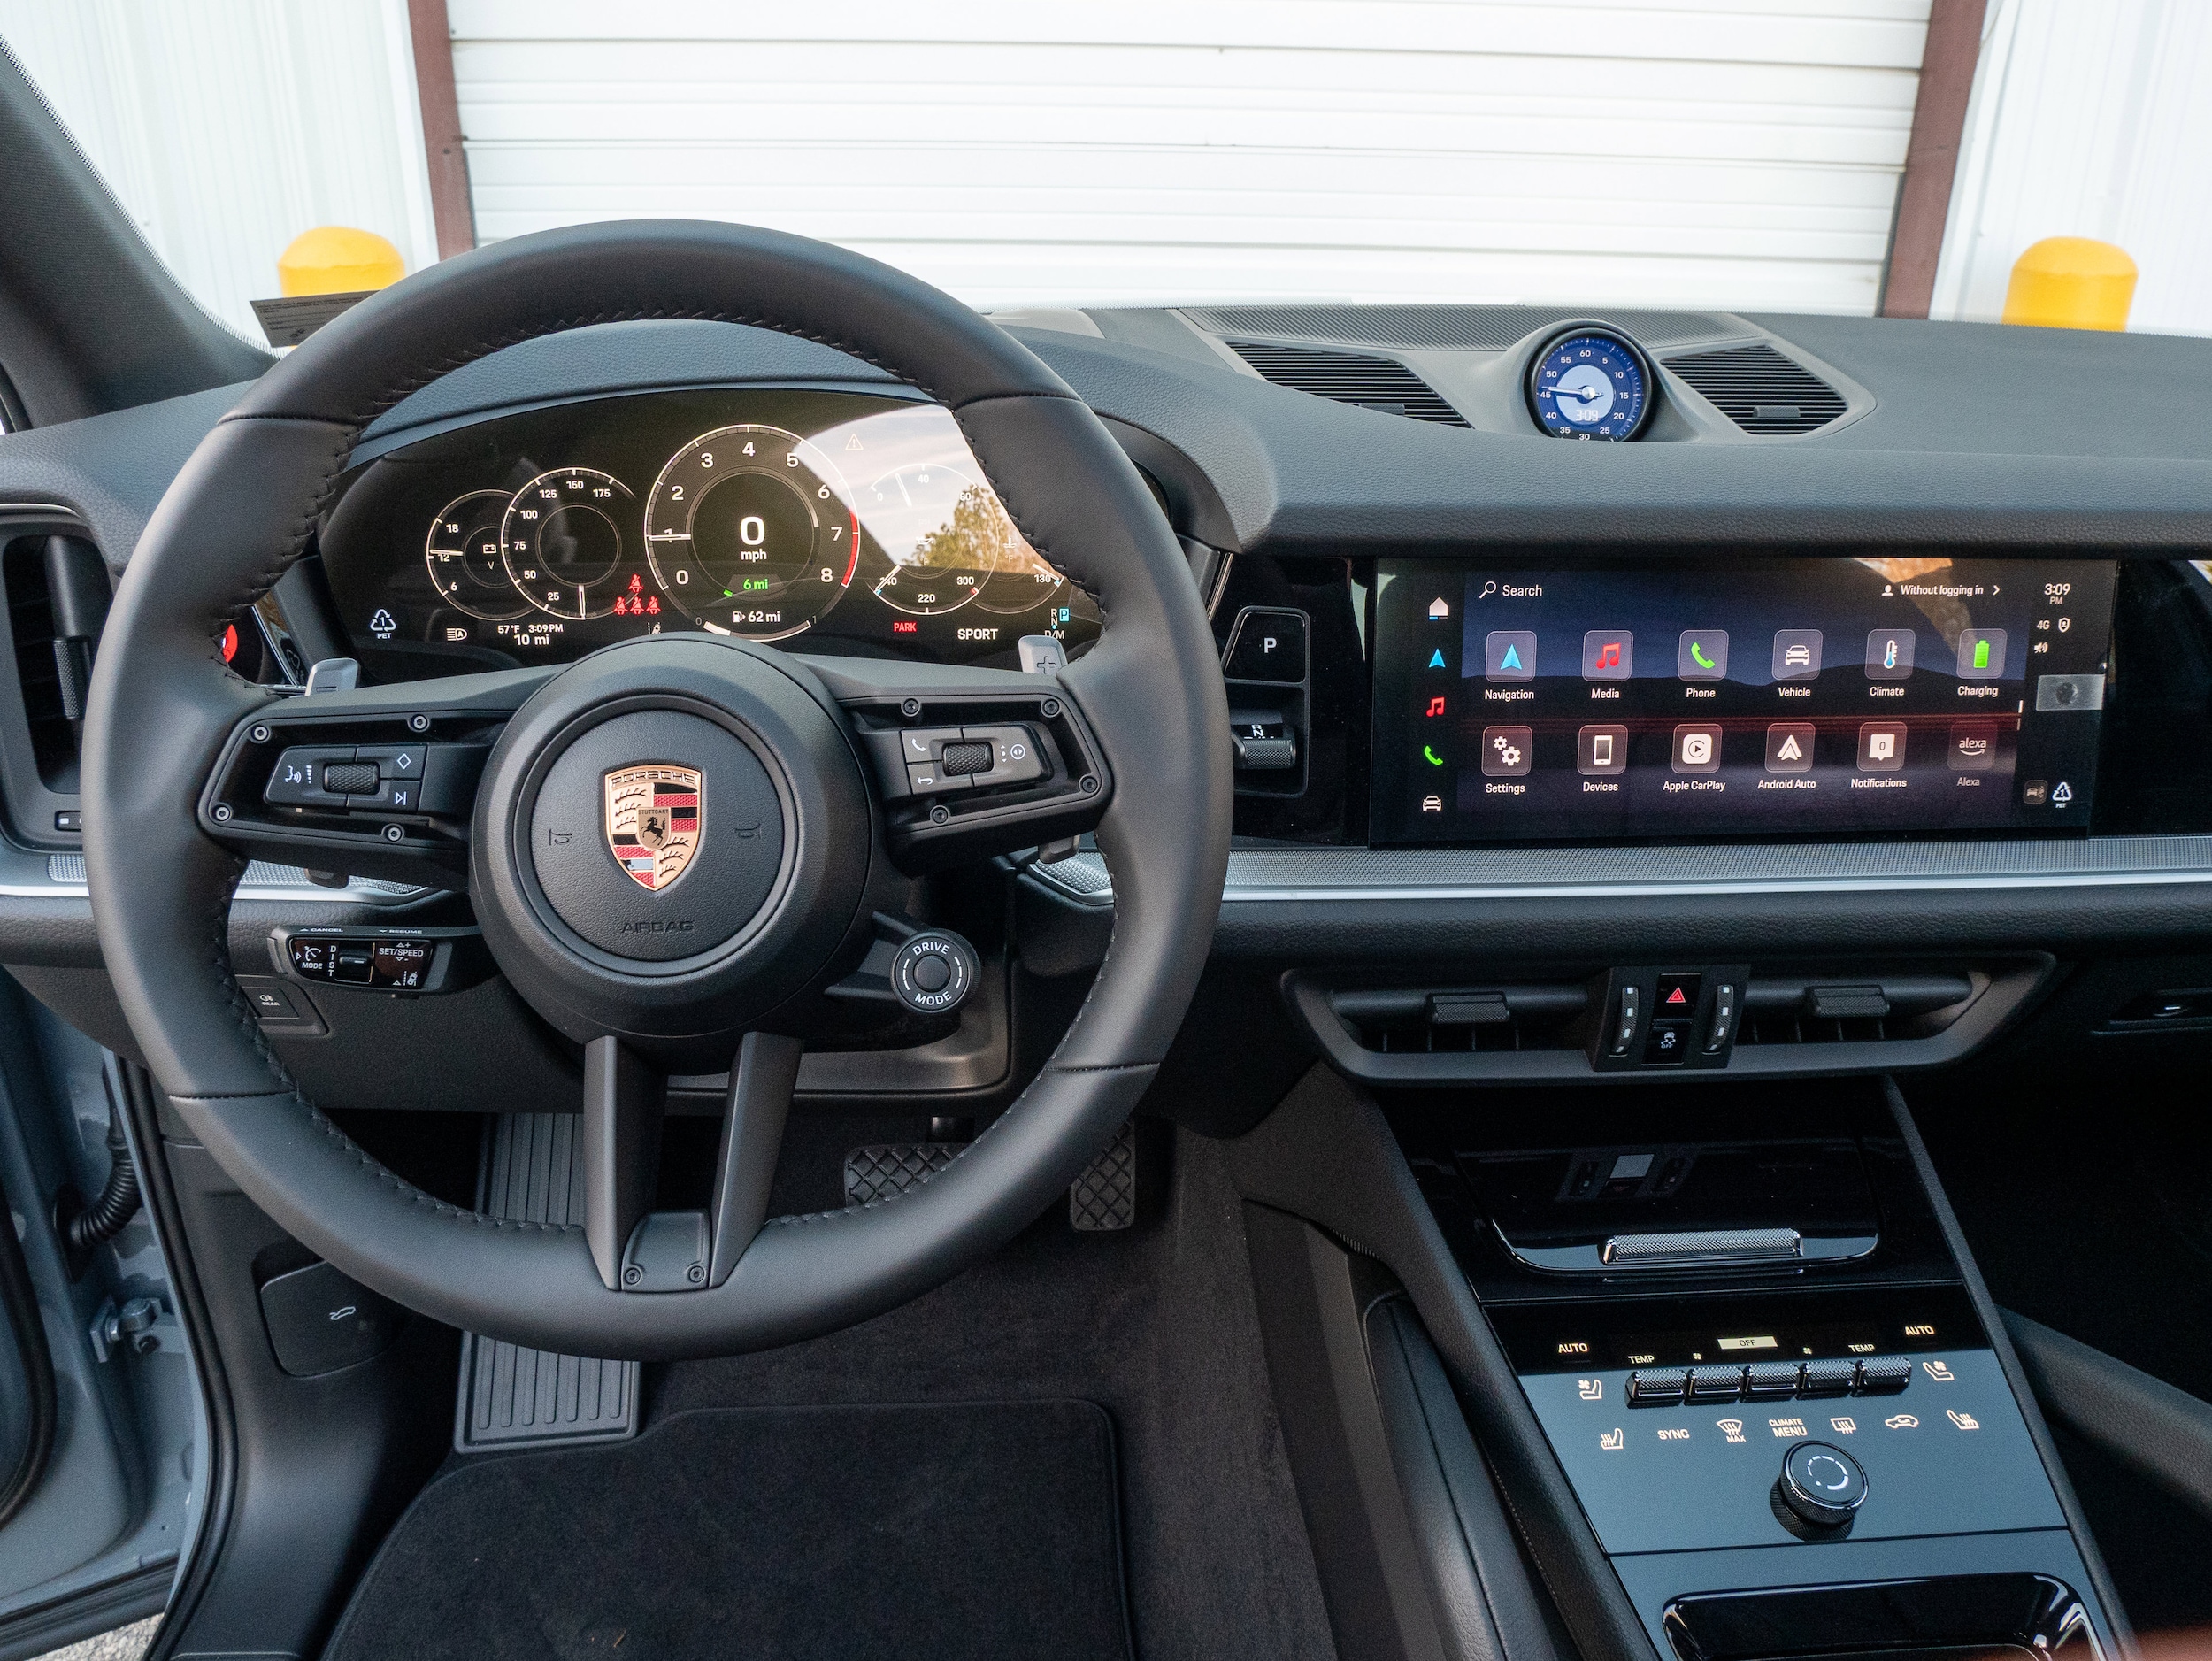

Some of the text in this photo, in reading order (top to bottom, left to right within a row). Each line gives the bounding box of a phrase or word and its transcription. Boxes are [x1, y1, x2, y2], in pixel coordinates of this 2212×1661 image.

[1575, 410, 1599, 421] 3:09
[741, 442, 756, 457] 4
[700, 452, 714, 468] 3
[786, 453, 799, 468] 5
[918, 474, 929, 483] 40
[565, 481, 584, 489] 150
[539, 489, 557, 498] 125
[593, 488, 611, 497] 175
[671, 485, 684, 500] 2
[818, 485, 830, 499] 6
[959, 492, 972, 502] 80
[520, 510, 538, 519] 100
[446, 524, 459, 533] 18
[740, 516, 765, 546] 0
[830, 526, 843, 542] 7
[513, 541, 526, 550] 75
[741, 550, 767, 562] mph
[487, 561, 495, 570] V
[524, 570, 537, 580] 50
[675, 569, 689, 585] 0
[819, 567, 833, 583] 8
[956, 575, 974, 586] 300
[1033, 573, 1052, 583] 130
[450, 581, 458, 591] 6
[742, 578, 769, 591] 6 mi
[2044, 583, 2071, 596] 3:09
[1502, 584, 1543, 598] Search
[1900, 584, 1984, 597] Without logging in
[547, 591, 560, 602] 25
[918, 593, 936, 603] 220
[2049, 596, 2063, 605] PM
[747, 611, 781, 623] 62 mi
[1050, 608, 1058, 618] R
[497, 624, 520, 634] 57°F
[528, 624, 549, 634] 3:09
[894, 621, 917, 633] PARK
[2036, 620, 2051, 630] 4G
[957, 628, 999, 640] SPORT
[513, 634, 550, 646] 10 mi
[1263, 637, 1277, 654] P
[1484, 688, 1535, 702] Navigation
[1591, 688, 1620, 699] Media
[1686, 687, 1716, 698] Phone
[1778, 686, 1811, 697] Vehicle
[1869, 686, 1905, 697] Climate
[1957, 685, 1999, 697] Charging
[1958, 738, 1987, 750] alexa
[611, 770, 697, 788] PORSCHE
[1757, 779, 1816, 789] Android Auto
[1850, 777, 1908, 788] Notifications
[1956, 776, 1981, 788] Alexa
[1485, 782, 1526, 795] Settings
[1582, 781, 1619, 793] Devices
[1663, 780, 1726, 793] Apple CarPlay
[621, 921, 694, 934] AIRBAG
[379, 948, 424, 957] SET/SPEED
[912, 942, 950, 956] DRIVE
[914, 990, 952, 1005] MODE
[1905, 1326, 1935, 1335] AUTO
[1558, 1343, 1589, 1354] AUTO
[1739, 1338, 1756, 1348] OFF
[1657, 1429, 1690, 1440] SYNC
[1772, 1427, 1808, 1438] MENU
